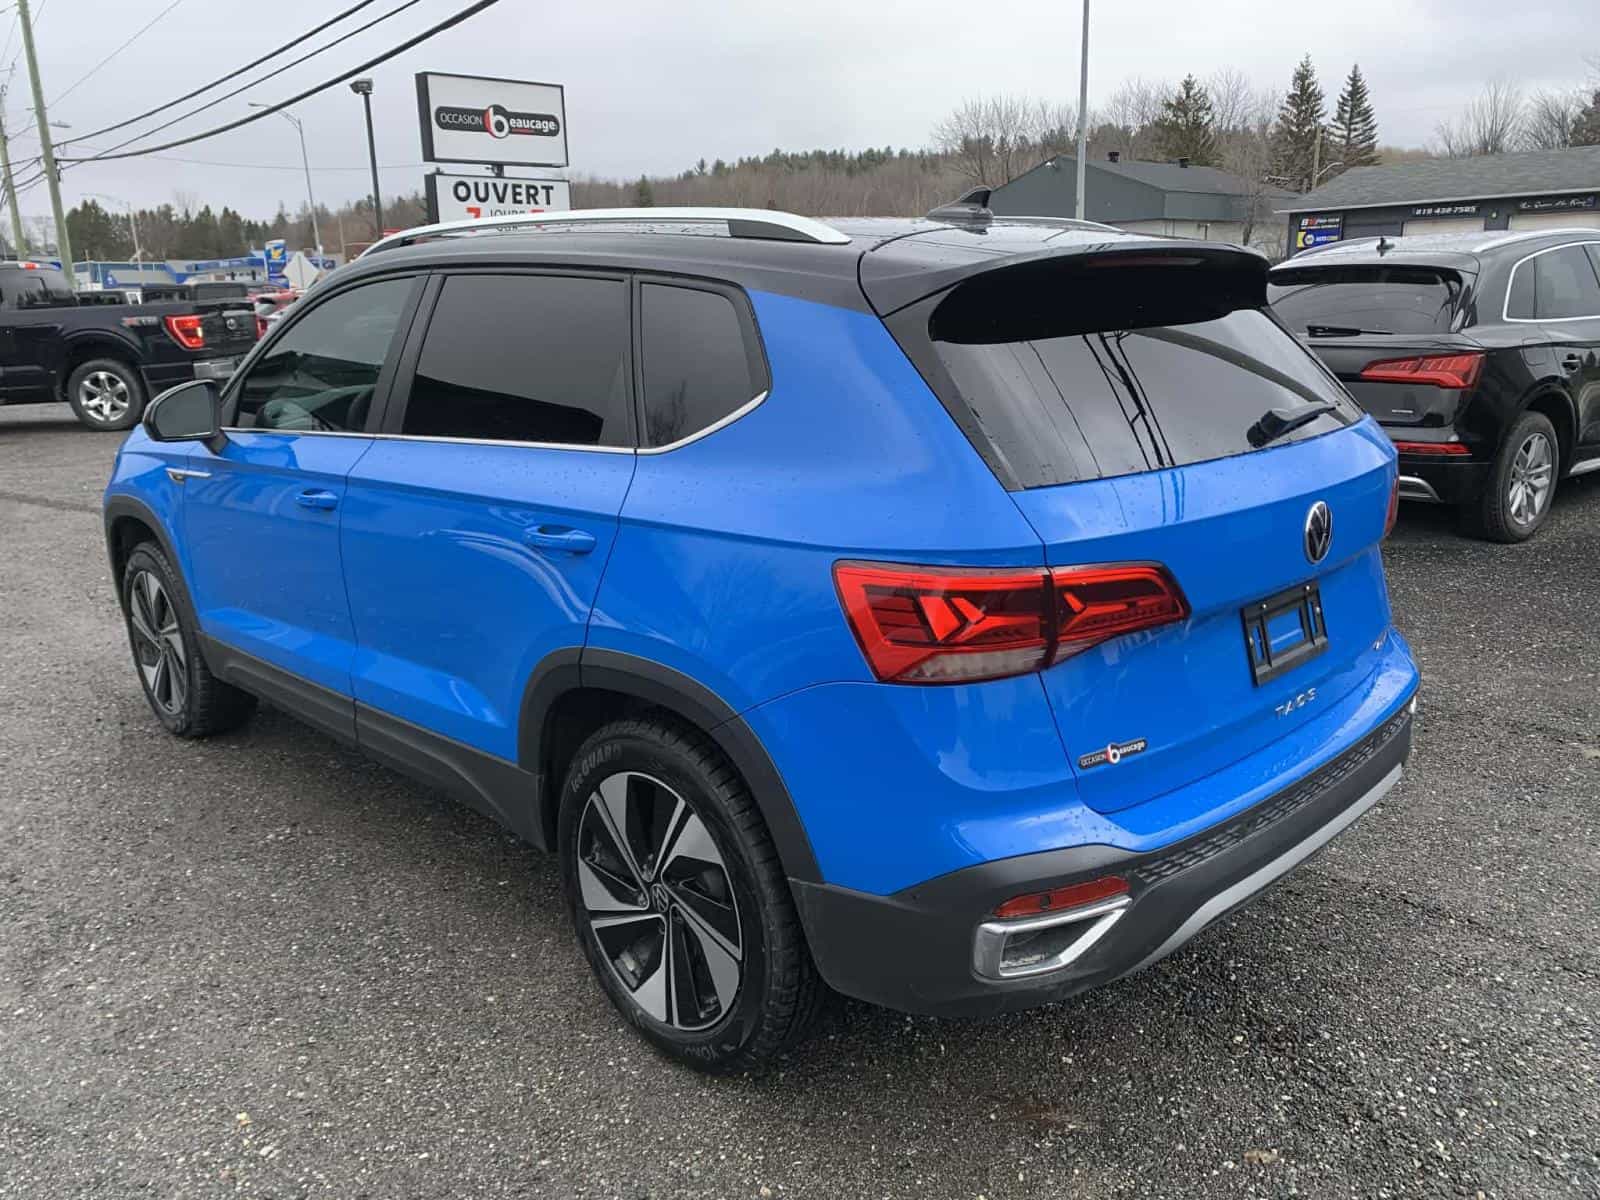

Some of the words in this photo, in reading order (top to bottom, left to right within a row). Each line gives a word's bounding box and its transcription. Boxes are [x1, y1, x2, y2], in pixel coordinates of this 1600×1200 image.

[440, 112, 482, 126] OCCASION
[452, 180, 555, 206] OUVERT
[1079, 753, 1107, 767] OCCASION
